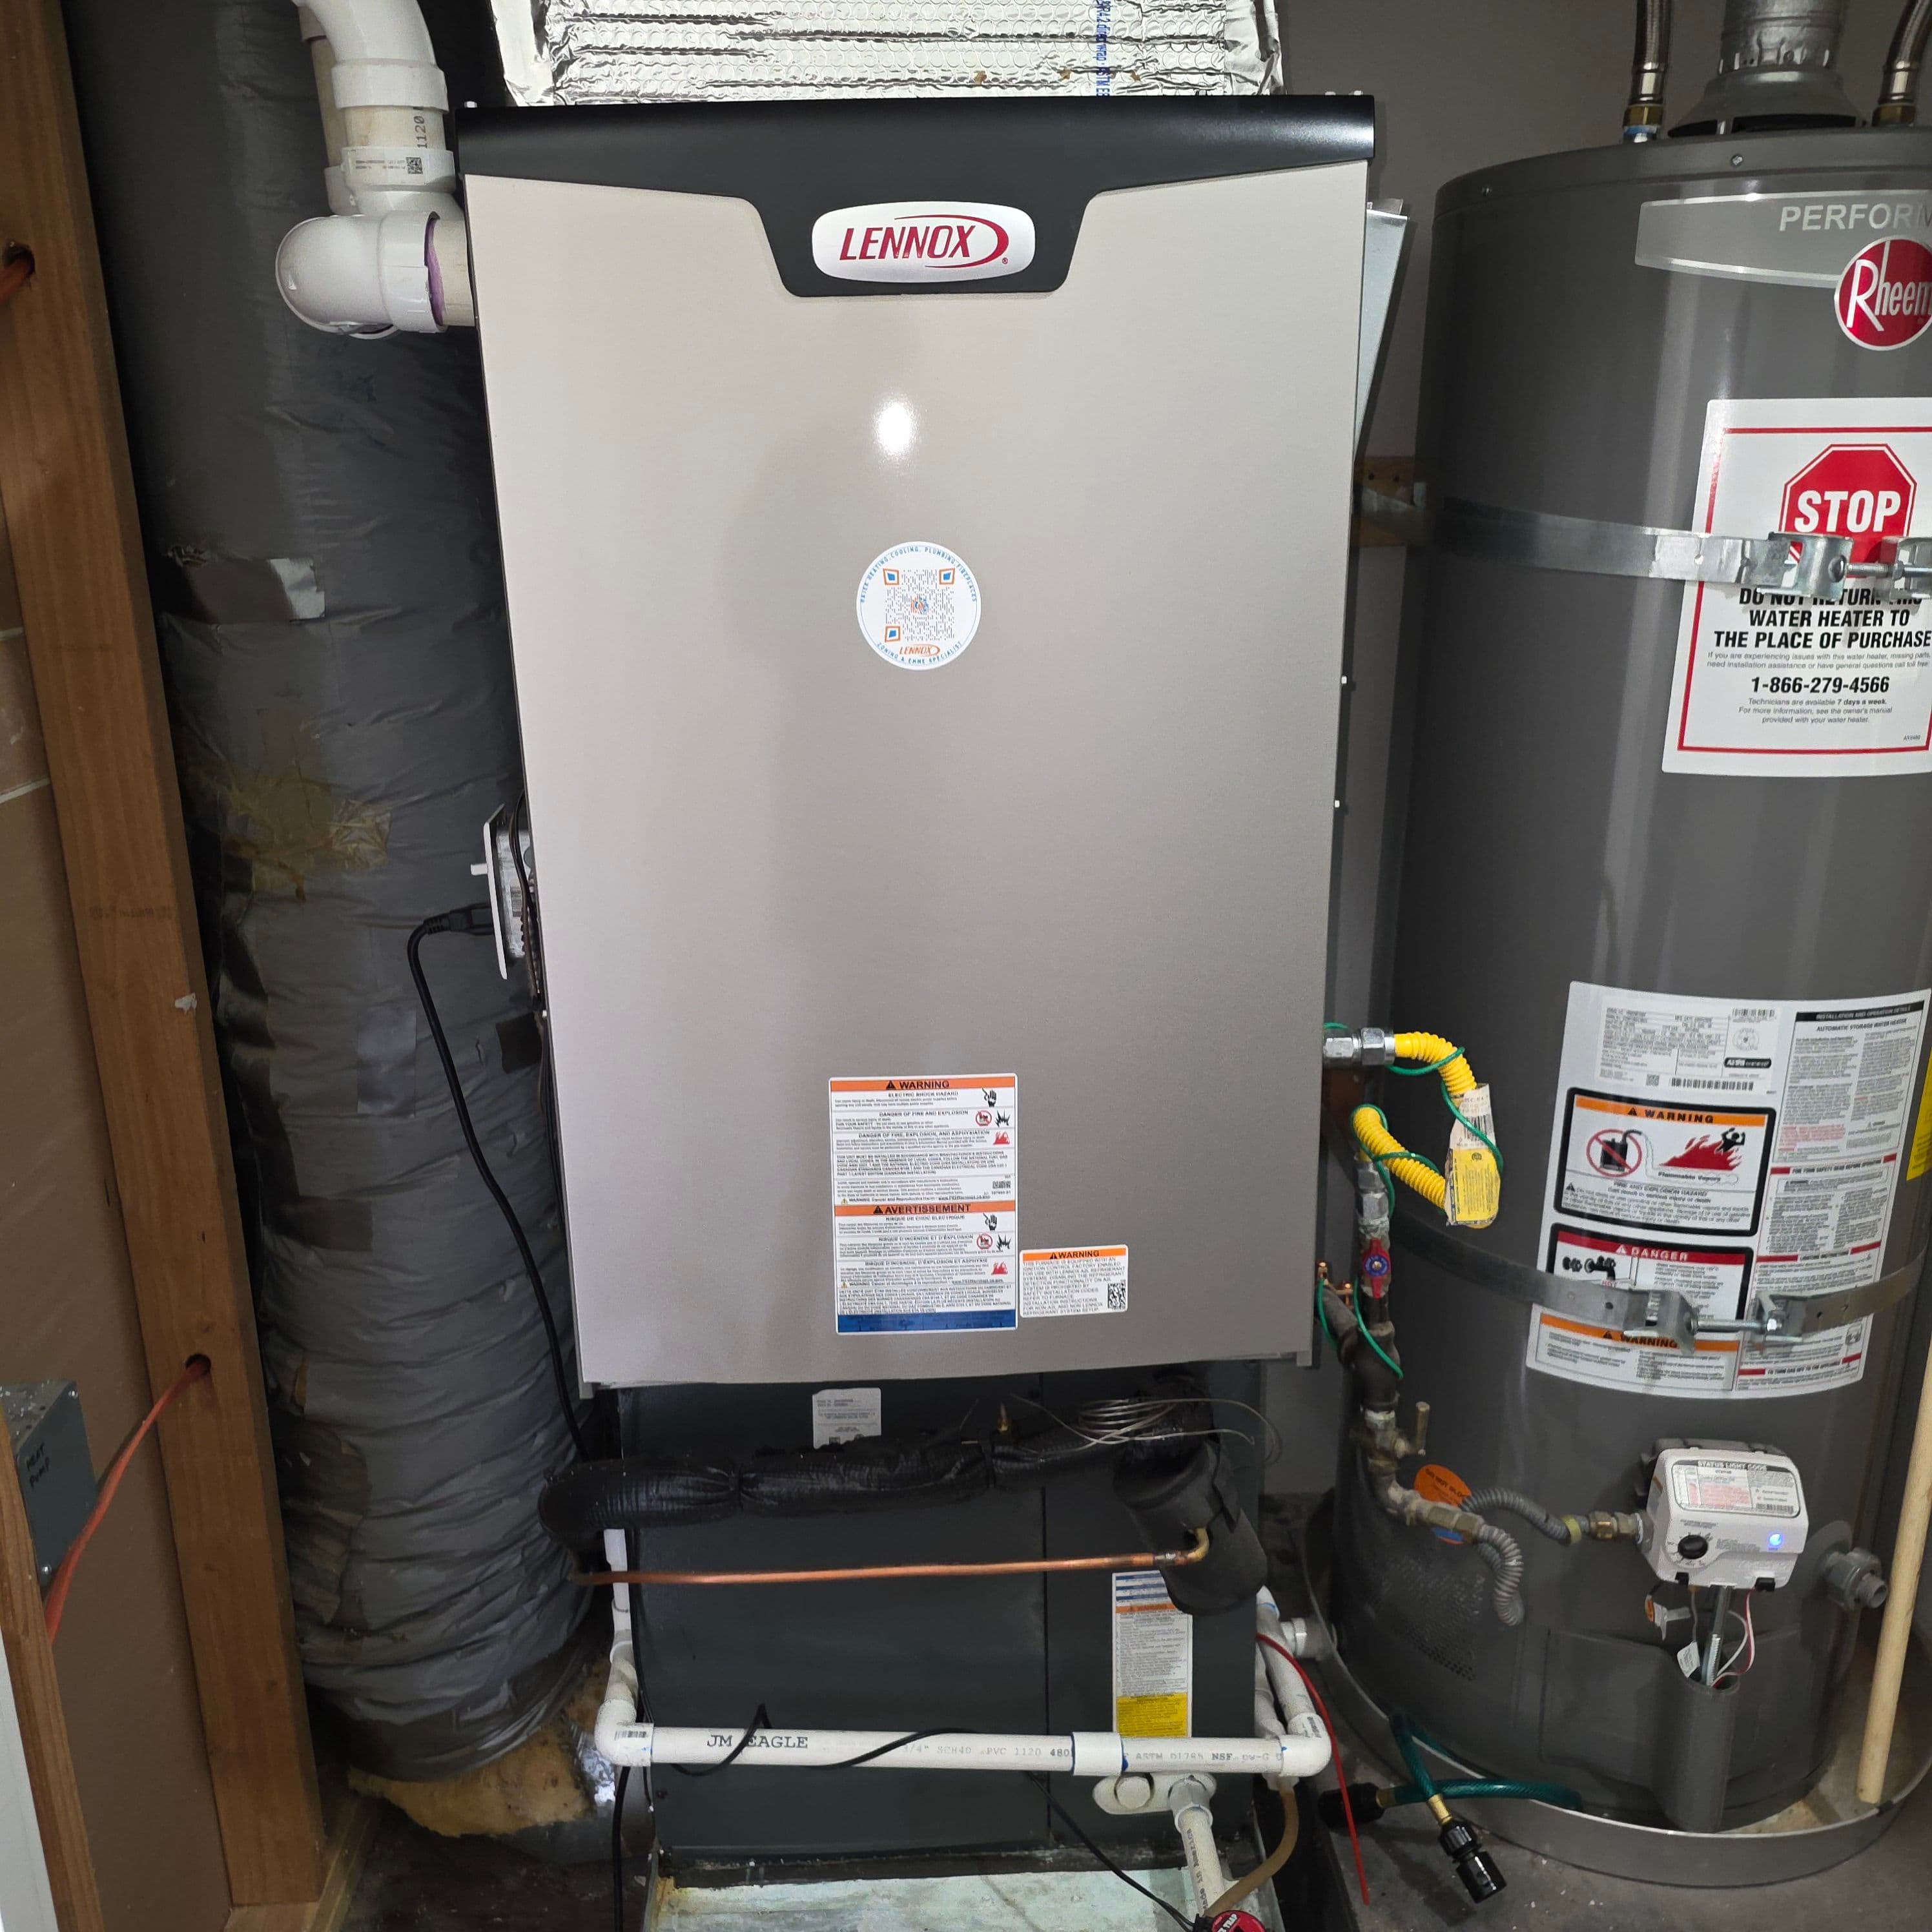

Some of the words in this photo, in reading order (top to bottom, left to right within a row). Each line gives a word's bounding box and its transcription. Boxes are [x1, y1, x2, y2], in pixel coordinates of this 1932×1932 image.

[1093, 44, 1107, 61] wrap
[413, 116, 427, 149] 1120
[839, 225, 976, 260] LENNOX
[1846, 240, 1932, 333] Rheem
[1794, 489, 1901, 533] STOP
[1740, 588, 1764, 605] DO
[1749, 610, 1812, 627] WATER
[1818, 610, 1884, 627] HEATER
[1890, 609, 1911, 626] TO
[1714, 630, 1749, 648] THE
[1755, 632, 1814, 648] PLACE
[1819, 632, 1844, 648] OF
[1847, 630, 1932, 648] PURCHASE
[1751, 676, 1890, 693] 1-866-279-4566
[899, 1079, 949, 1089] WARNING
[1645, 1109, 1714, 1124] WARNING
[884, 1203, 971, 1215] AVERTISSEMENT
[1058, 1250, 1099, 1259] WARNING
[1631, 1248, 1689, 1262] DANGER
[706, 1734, 733, 1747] JM
[746, 1735, 808, 1749] EAGLE
[1014, 1747, 1042, 1757] 1120
[1050, 1749, 1072, 1758] 480
[1211, 1752, 1233, 1762] NSF
[1187, 1828, 1200, 1868] America
